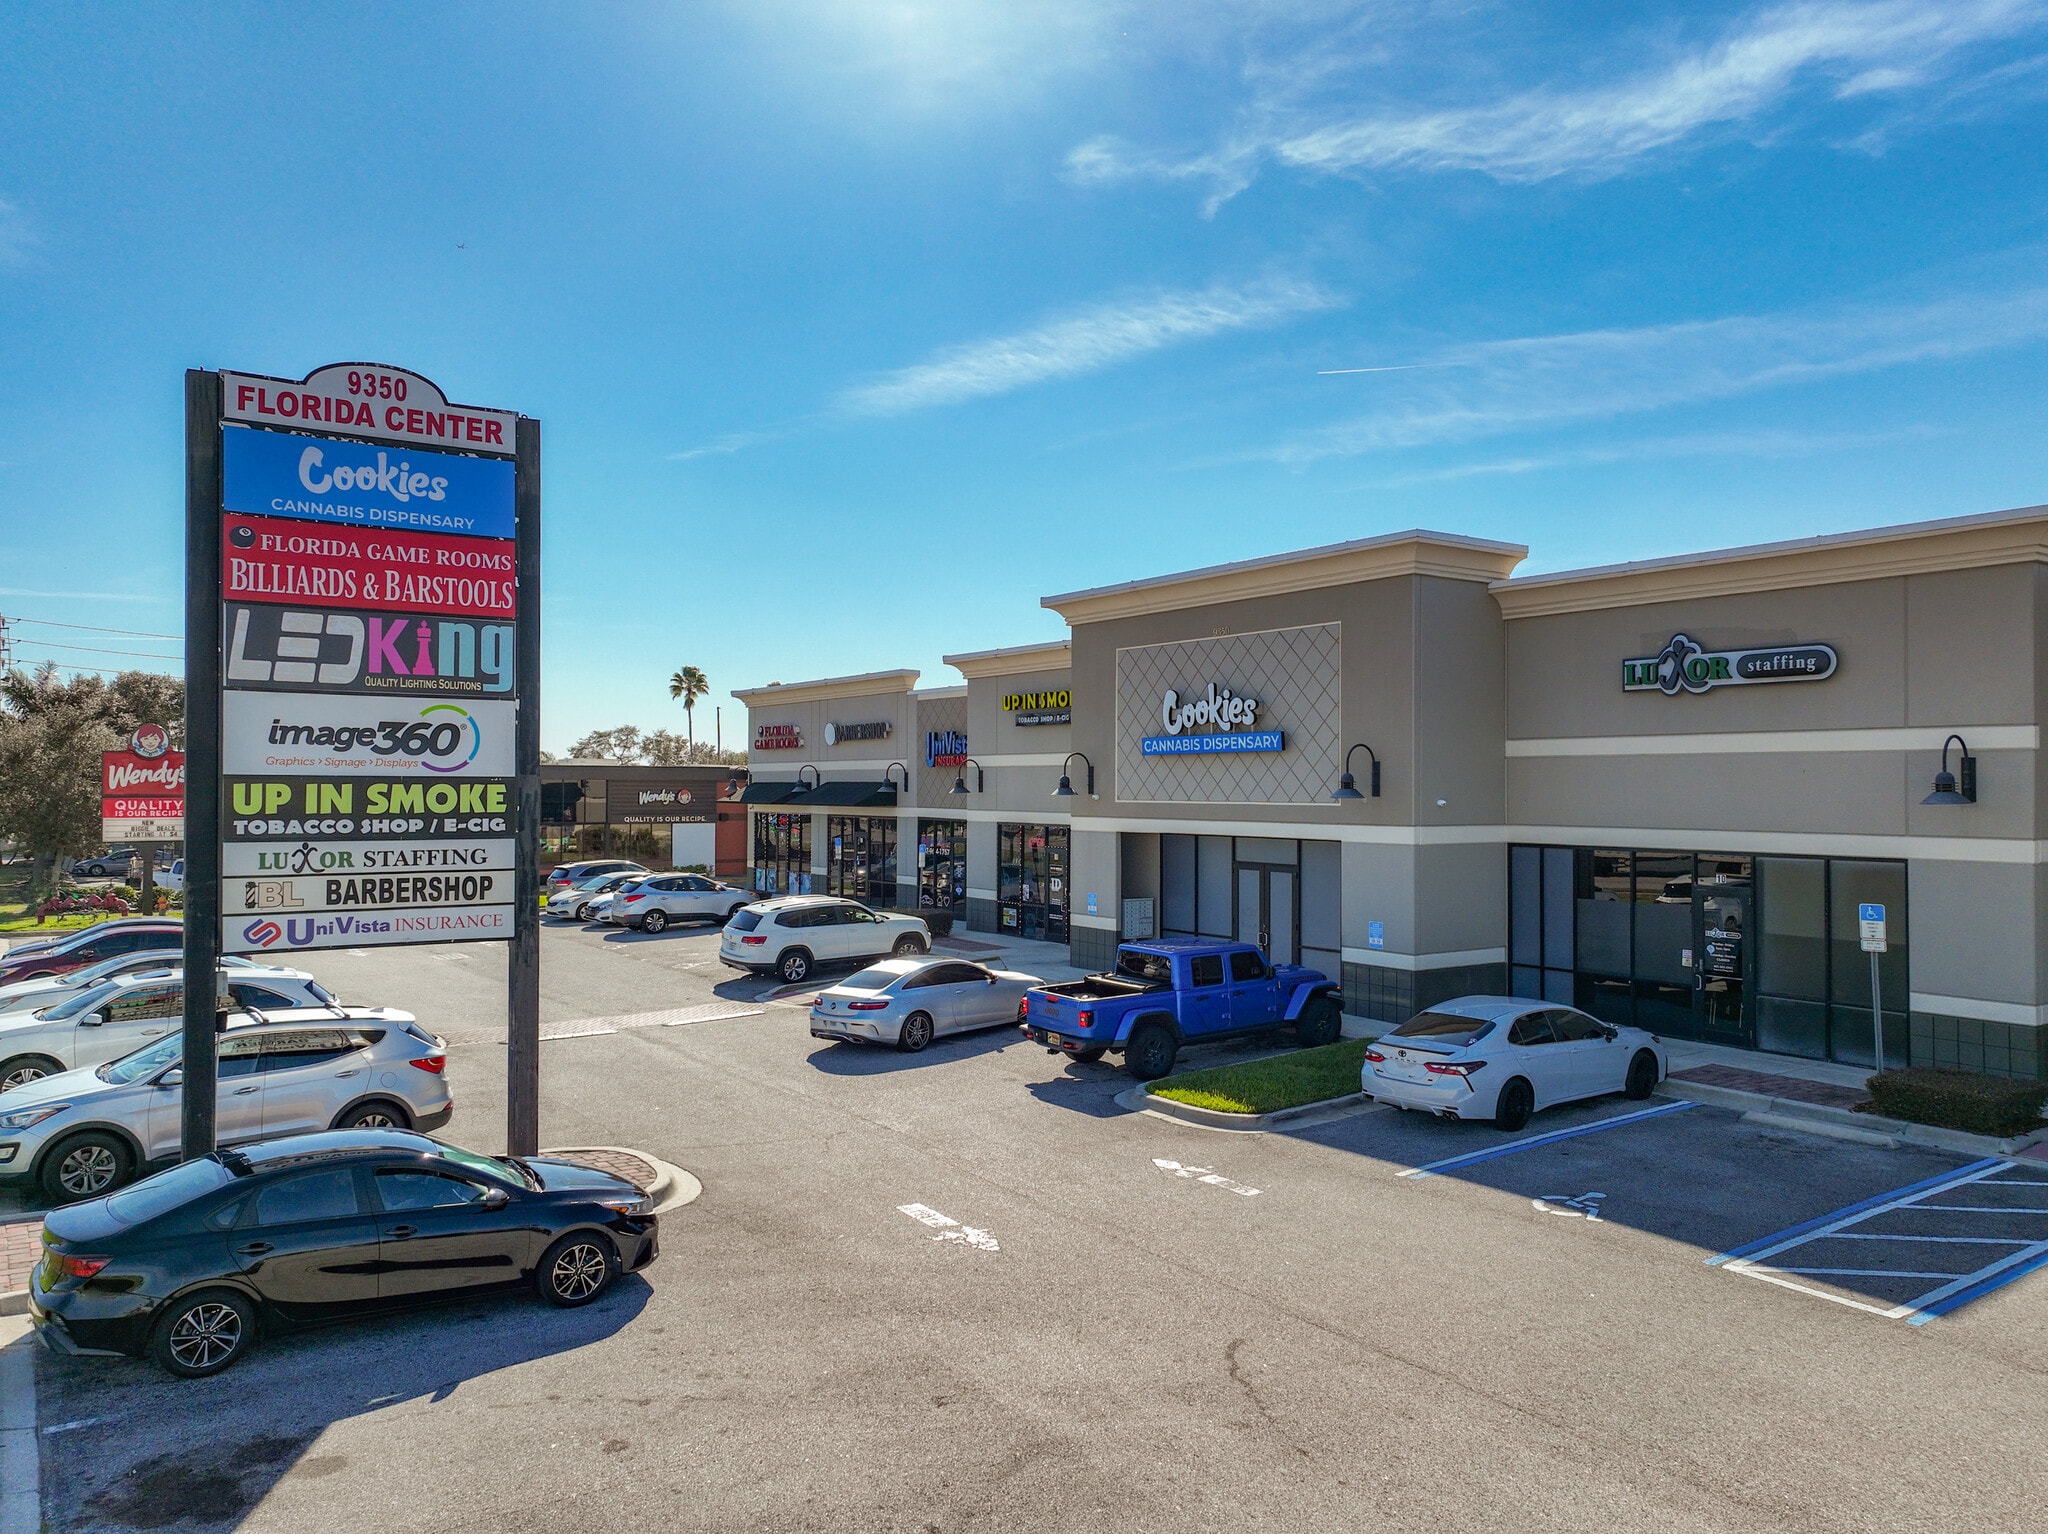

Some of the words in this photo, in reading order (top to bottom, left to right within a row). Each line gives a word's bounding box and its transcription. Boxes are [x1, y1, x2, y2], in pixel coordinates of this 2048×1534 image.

[348, 371, 407, 401] 9350
[237, 385, 375, 428] FLORIDA
[385, 407, 504, 445] CENTER
[299, 446, 449, 502] Cookies
[271, 498, 364, 519] CANNABIS
[370, 508, 474, 530] DISPENSARY
[260, 534, 361, 559] FLORIDA
[367, 543, 430, 564] GAME
[436, 550, 512, 571] ROOMS
[230, 558, 357, 600] BILLIARDS
[363, 573, 380, 601] &
[385, 570, 513, 610] BARSTOOLS
[1624, 640, 1733, 690] LUXOR
[1747, 654, 1817, 672] staffing
[365, 676, 398, 687] QUALITY
[400, 677, 437, 689] LIGHTING
[439, 679, 482, 691] SOLUTIONS
[1002, 694, 1020, 711] UP
[1022, 693, 1037, 710] IN
[1162, 682, 1257, 735] Cookies
[926, 731, 967, 768] UniVist
[1143, 737, 1201, 753] CANNABIS
[1203, 735, 1280, 751] DISPENSARY
[265, 756, 315, 767] Graphics
[324, 757, 366, 768] Signage
[374, 758, 419, 769] Displays
[115, 800, 183, 810] QUALITY
[233, 783, 292, 815] UP
[305, 783, 352, 814] IN
[366, 783, 508, 814] SMOKE
[639, 789, 676, 805] Wendy's
[233, 819, 354, 835] TOBACCO
[360, 818, 425, 834] SHOP
[443, 818, 506, 832] E-CIG
[258, 842, 355, 873] LUXOR
[363, 848, 488, 869] STAFFING
[326, 876, 493, 906] BARBERSHOP
[1716, 874, 1727, 883] 10
[287, 916, 390, 946] UniVista
[395, 913, 503, 932] INSURANCE
